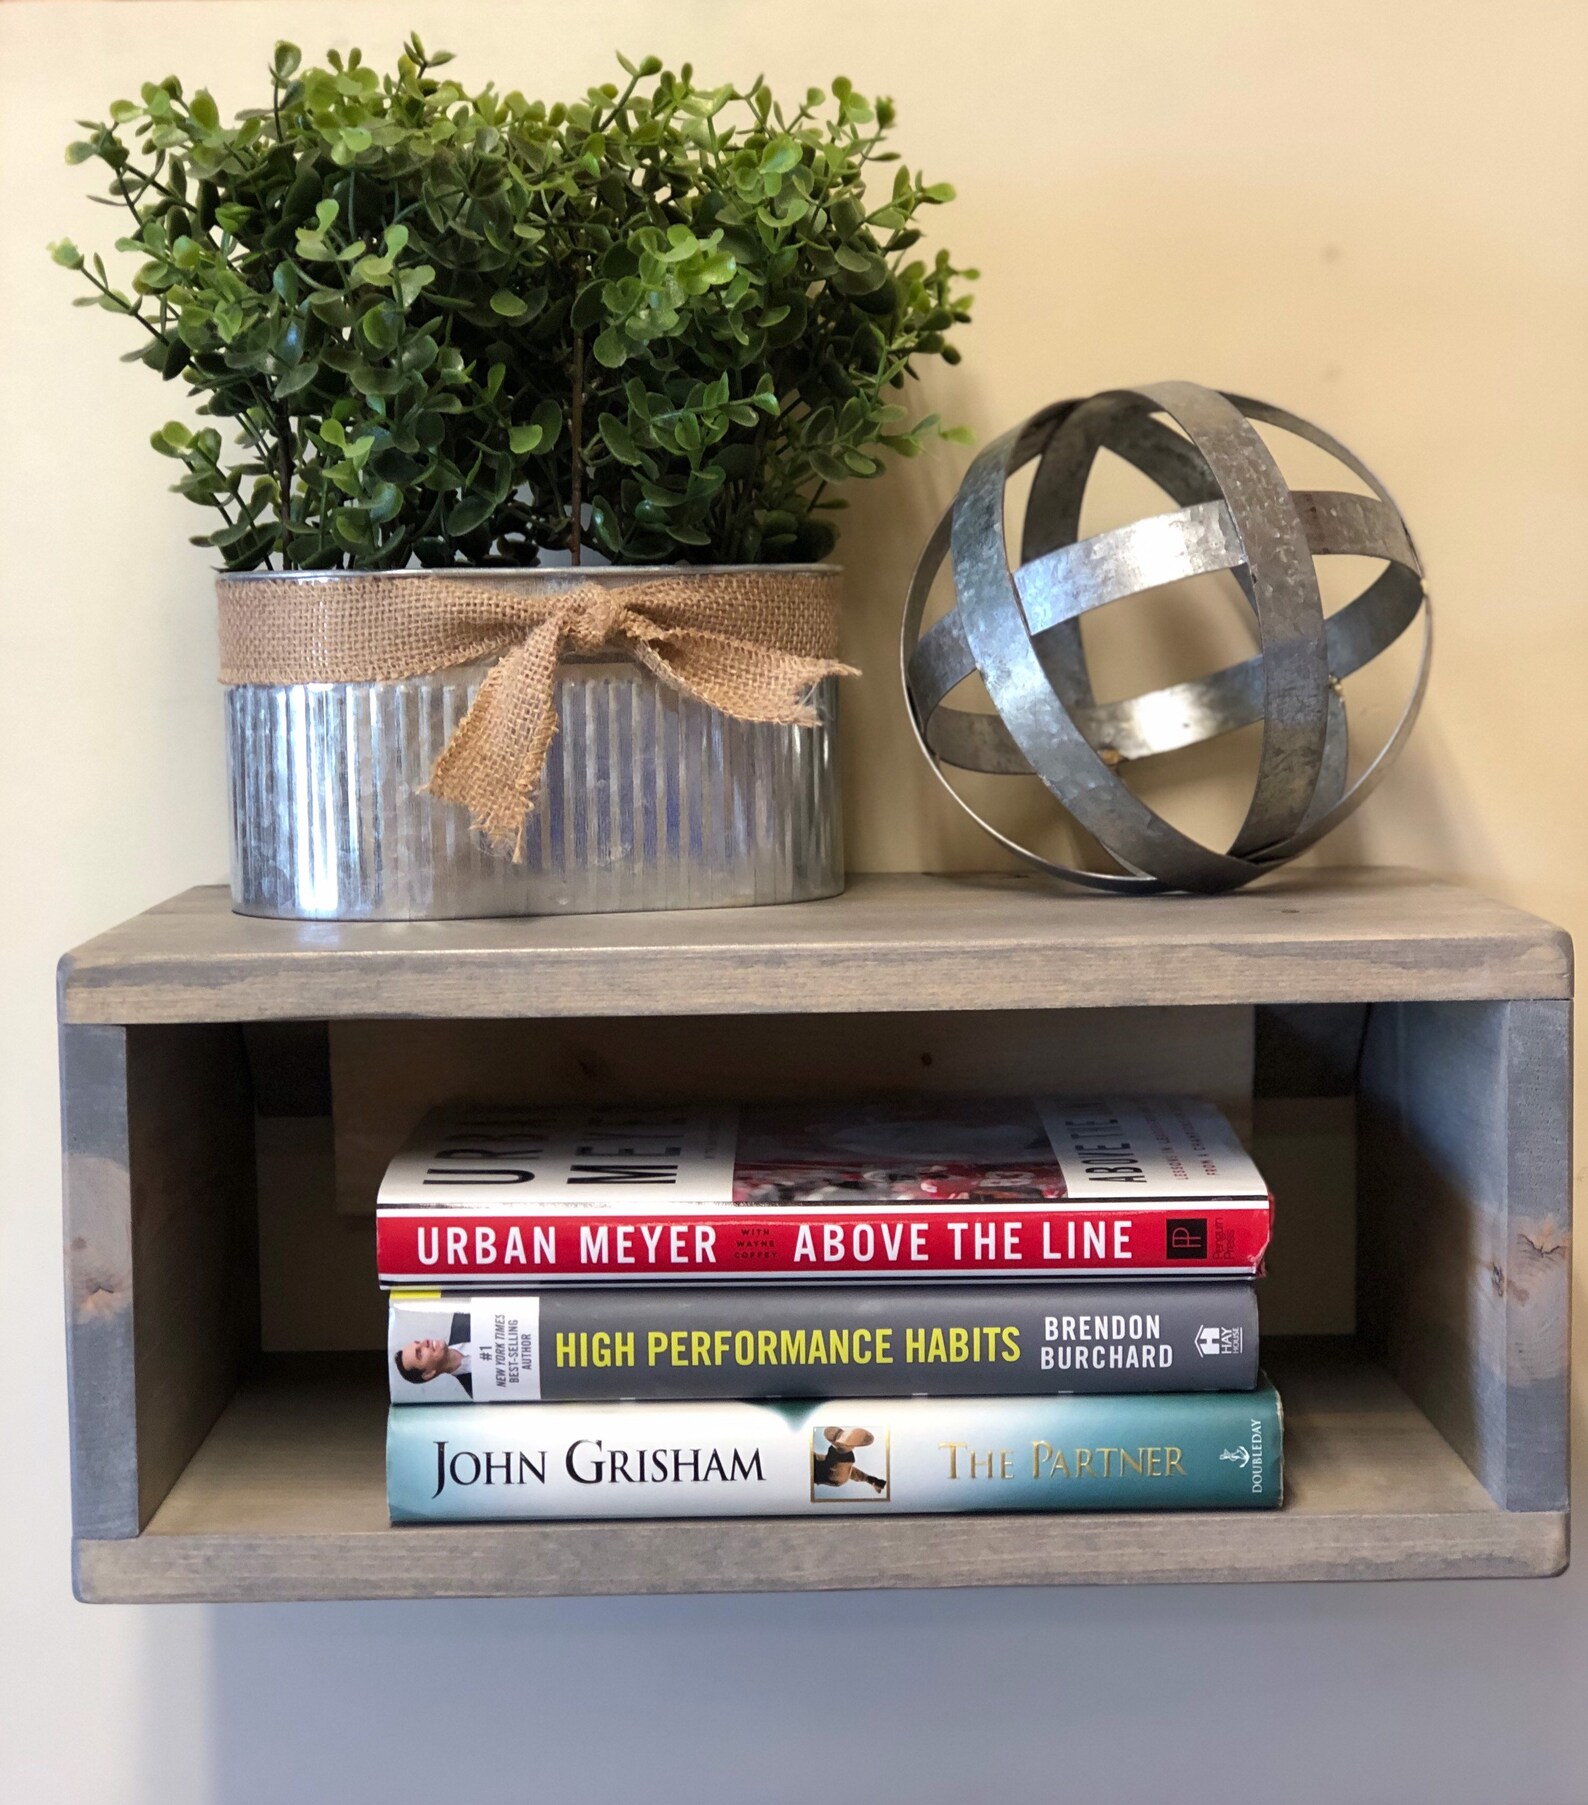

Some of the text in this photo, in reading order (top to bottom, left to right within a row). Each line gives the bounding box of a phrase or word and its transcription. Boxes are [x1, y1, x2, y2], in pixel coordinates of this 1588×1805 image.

[1074, 1143, 1147, 1183] ABOVE
[417, 1224, 718, 1266] URBAN MEYER
[735, 1240, 775, 1248] WAYNE
[741, 1228, 770, 1236] WITH
[793, 1219, 1134, 1263] ABOVE THE LINE
[555, 1326, 1022, 1368] HIGH PERFORMANCE HABITS
[1044, 1314, 1161, 1342] BRENDON
[1221, 1326, 1232, 1354] HAY
[1232, 1327, 1240, 1354] HOUSE
[479, 1346, 492, 1361] #1
[495, 1314, 506, 1388] NEW YORK TIMES
[508, 1319, 519, 1384] BEST-SELLING
[521, 1333, 532, 1370] AUTHOR
[1040, 1344, 1174, 1371] BURCHARD
[431, 1438, 767, 1499] JOHN GRISHAM
[937, 1439, 1187, 1480] THE PARTNER
[1250, 1418, 1263, 1493] DOUBLEDAY
